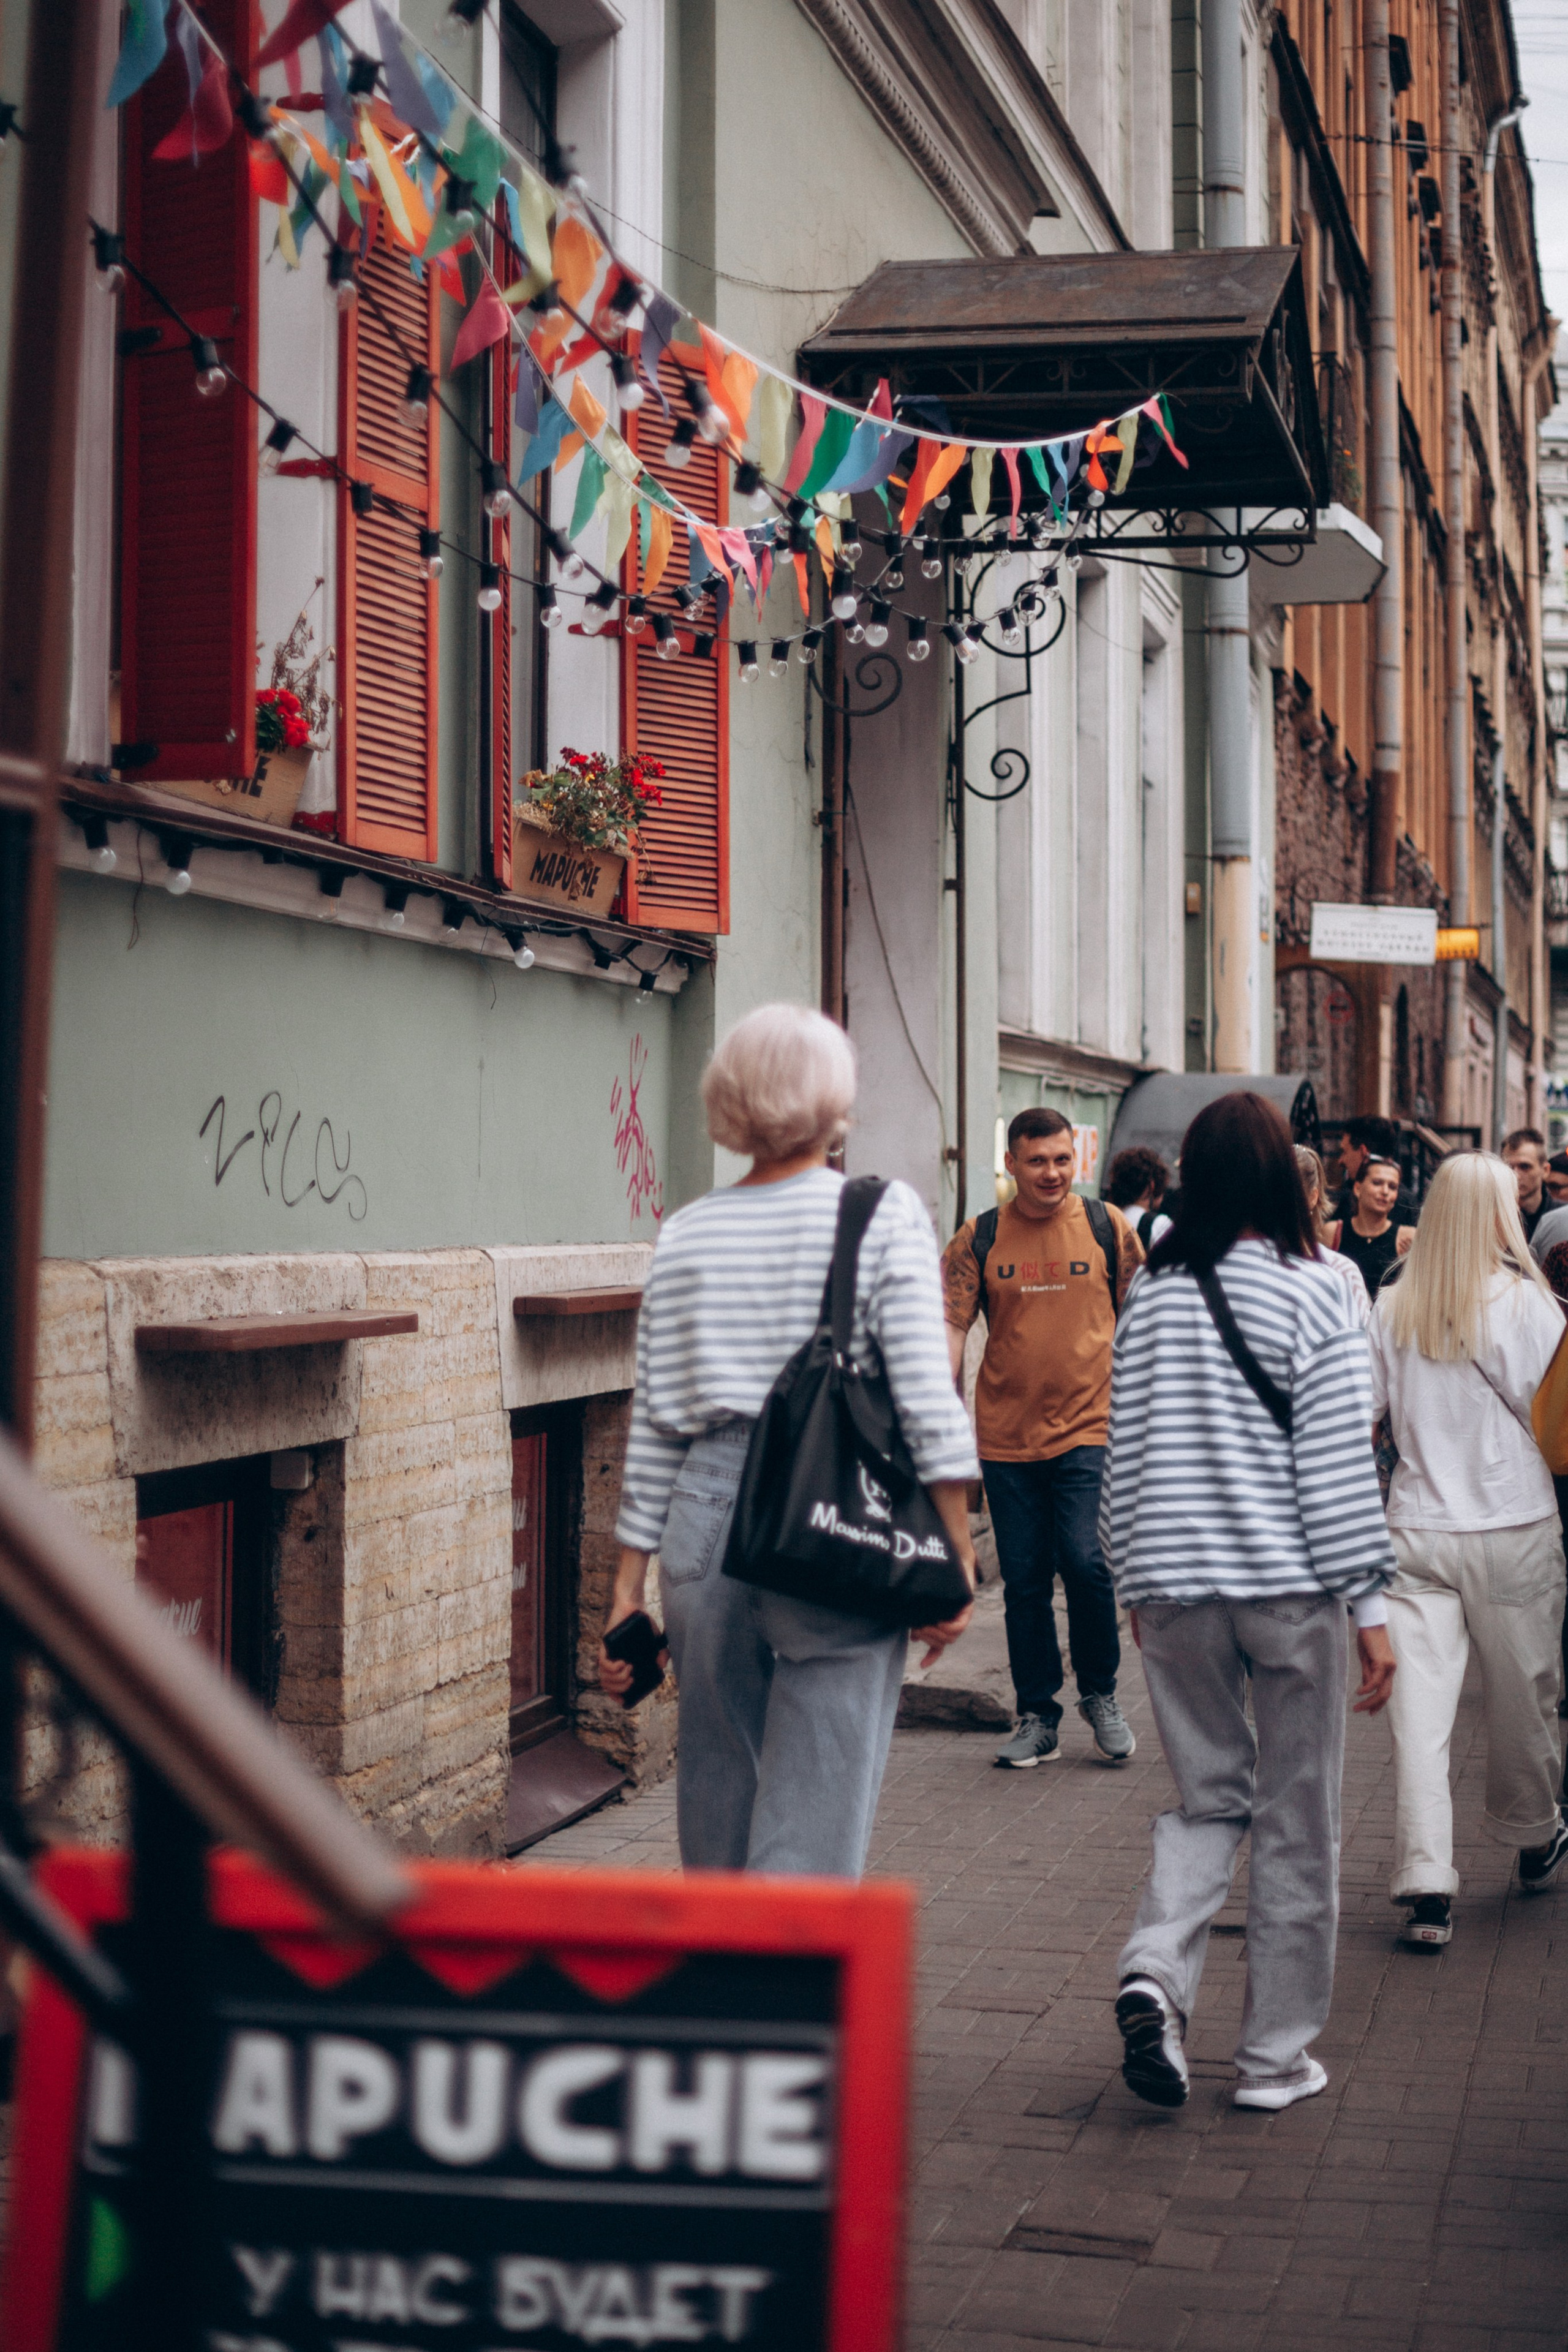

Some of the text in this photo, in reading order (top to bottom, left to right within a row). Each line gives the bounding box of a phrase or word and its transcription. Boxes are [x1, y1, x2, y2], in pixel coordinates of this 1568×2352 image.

[811, 1502, 948, 1560] Massimo Dutti
[233, 2242, 772, 2342] У НАС БУДЕТ
